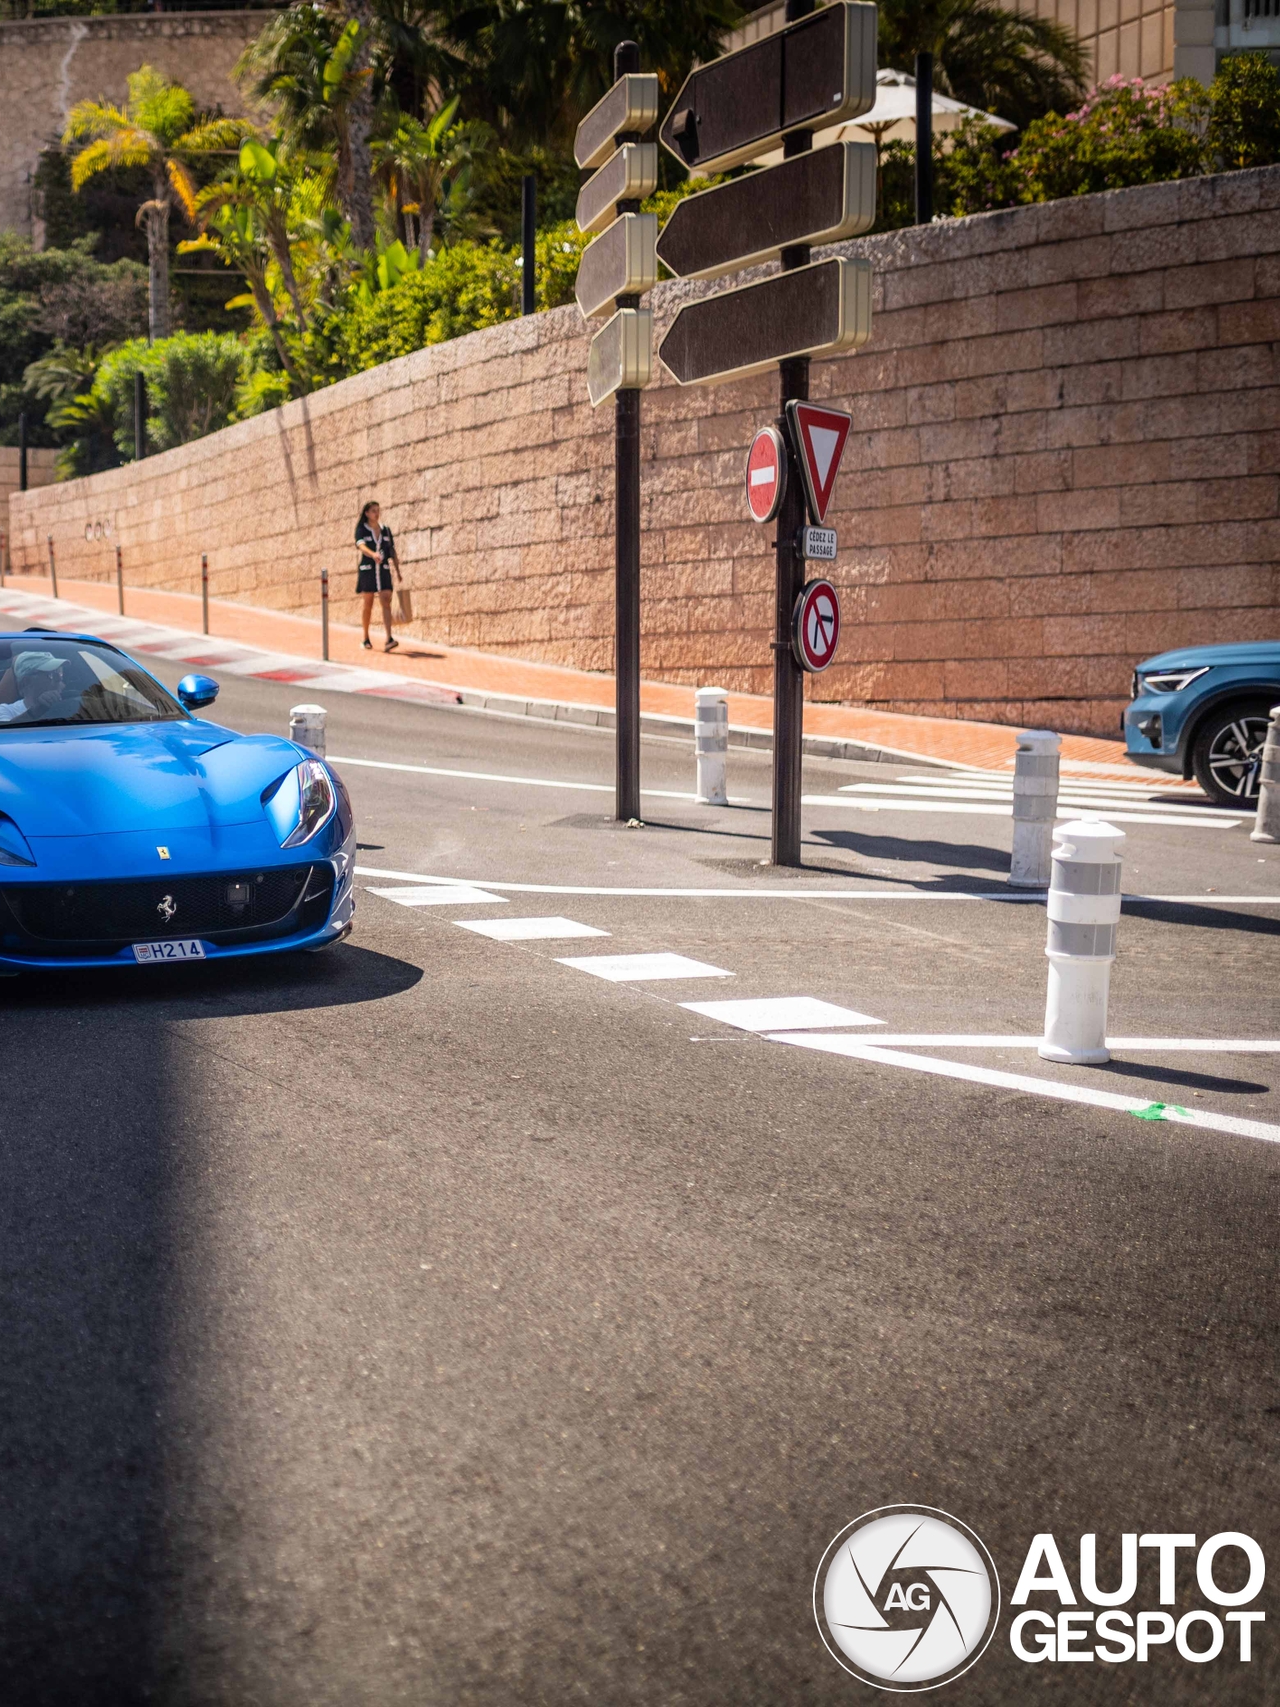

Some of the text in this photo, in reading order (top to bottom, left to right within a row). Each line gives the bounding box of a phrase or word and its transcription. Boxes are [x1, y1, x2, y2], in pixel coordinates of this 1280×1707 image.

[809, 530, 834, 544] CÉDEZ LE
[809, 544, 833, 556] PASSAGE
[151, 942, 200, 958] H214
